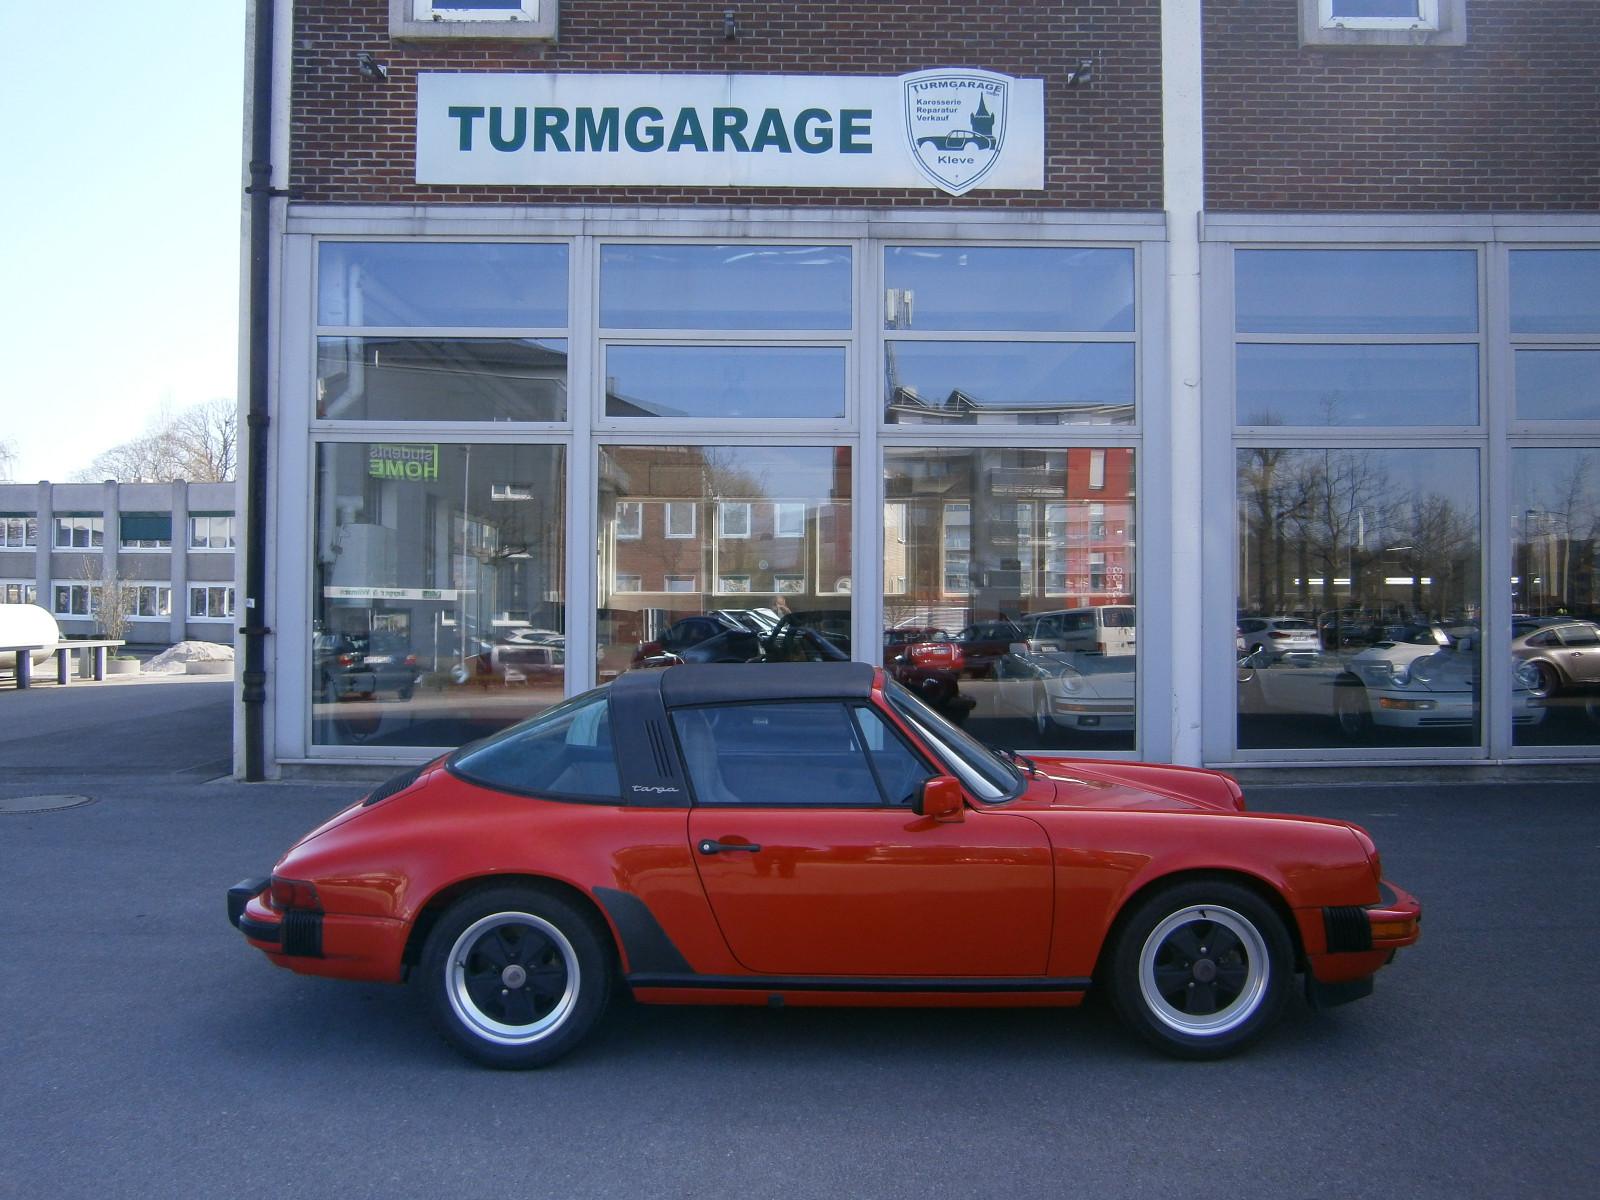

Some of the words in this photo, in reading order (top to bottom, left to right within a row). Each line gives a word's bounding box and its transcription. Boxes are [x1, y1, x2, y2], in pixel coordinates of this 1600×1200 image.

[911, 81, 1003, 94] TURMGARAGE
[916, 98, 962, 106] Karosserie
[916, 106, 958, 114] Reparatur
[916, 114, 949, 122] Verkauf
[448, 105, 873, 154] TURMGARAGE
[937, 155, 975, 164] Kleve
[631, 785, 679, 794] targa
